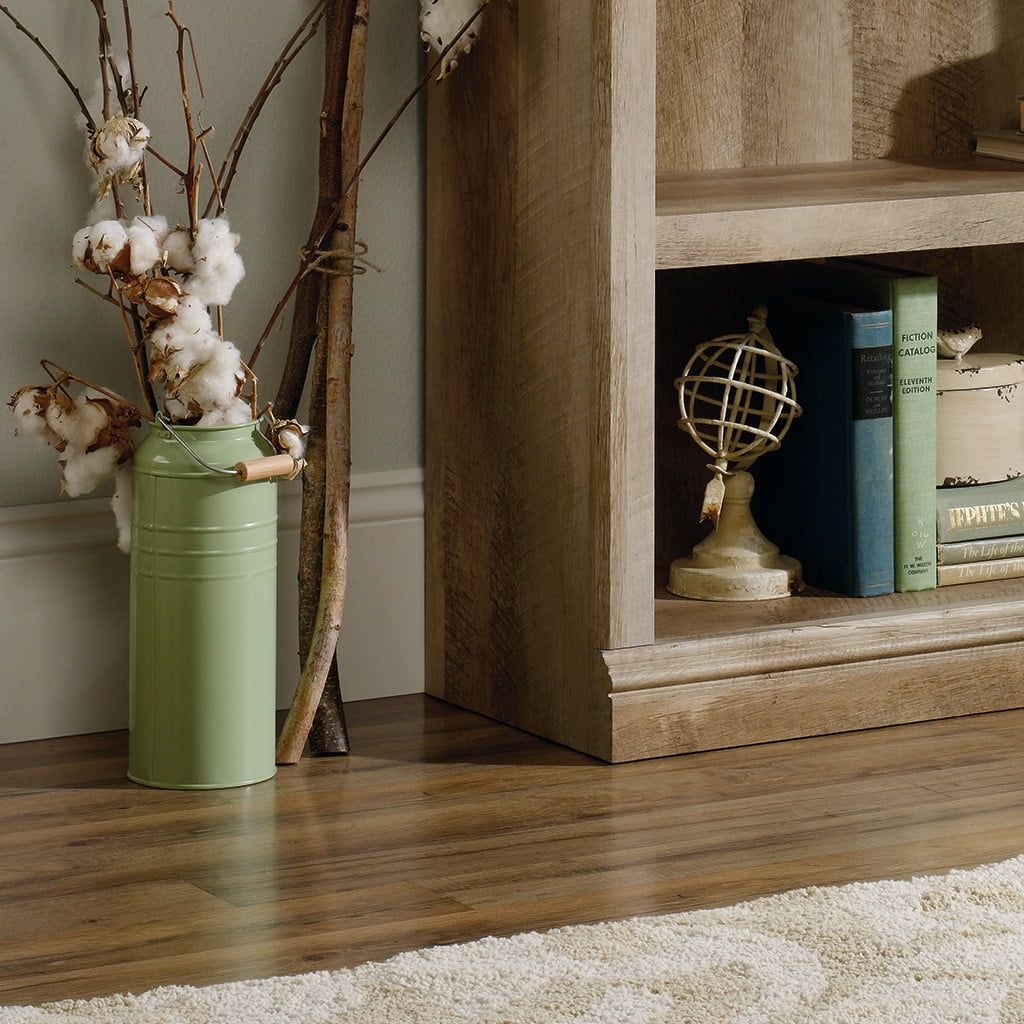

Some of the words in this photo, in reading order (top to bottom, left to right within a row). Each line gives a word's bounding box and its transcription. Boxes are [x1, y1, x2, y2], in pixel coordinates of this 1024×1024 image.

[901, 332, 933, 343] FICTION
[898, 346, 936, 357] CATALOG
[899, 377, 933, 386] ELEVENTH
[901, 386, 931, 394] EDITION
[962, 547, 979, 558] The
[980, 544, 999, 558] Life
[1000, 543, 1009, 556] of
[1010, 542, 1023, 553] the
[959, 566, 976, 578] The
[979, 565, 998, 578] Life
[1000, 565, 1009, 576] of
